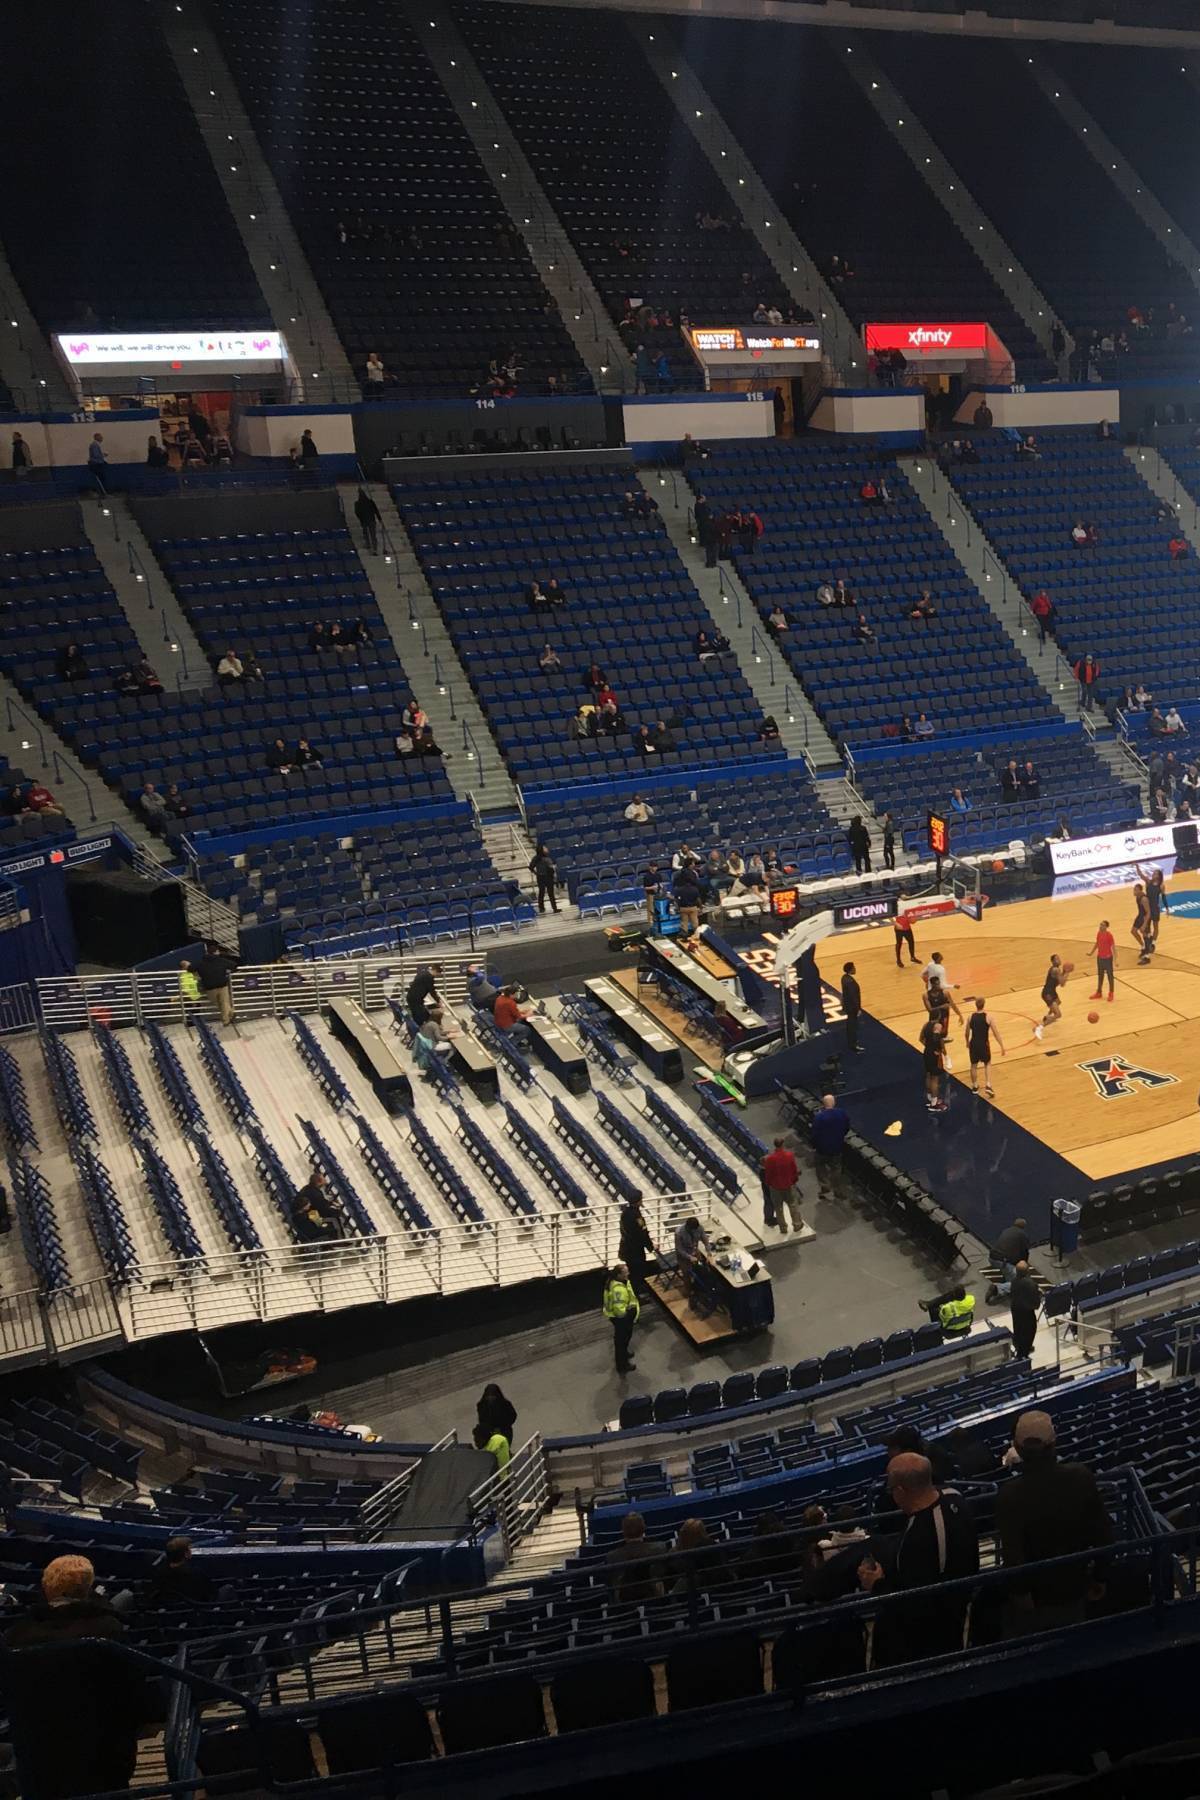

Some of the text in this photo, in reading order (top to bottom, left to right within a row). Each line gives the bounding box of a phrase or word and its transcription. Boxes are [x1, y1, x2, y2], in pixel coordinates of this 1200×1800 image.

[696, 334, 735, 344] WATCH
[907, 327, 952, 346] xfinity
[747, 337, 820, 350] WatchForMeCT.org
[1009, 384, 1027, 393] 116
[745, 392, 764, 402] 115
[475, 399, 495, 409] 114
[71, 412, 95, 423] 113
[932, 831, 944, 850] 30
[1137, 836, 1164, 847] UCONN
[69, 839, 110, 856] BUD LIGHT
[1056, 848, 1092, 860] KeyBank
[778, 901, 792, 913] 30
[843, 902, 888, 920] UCONN
